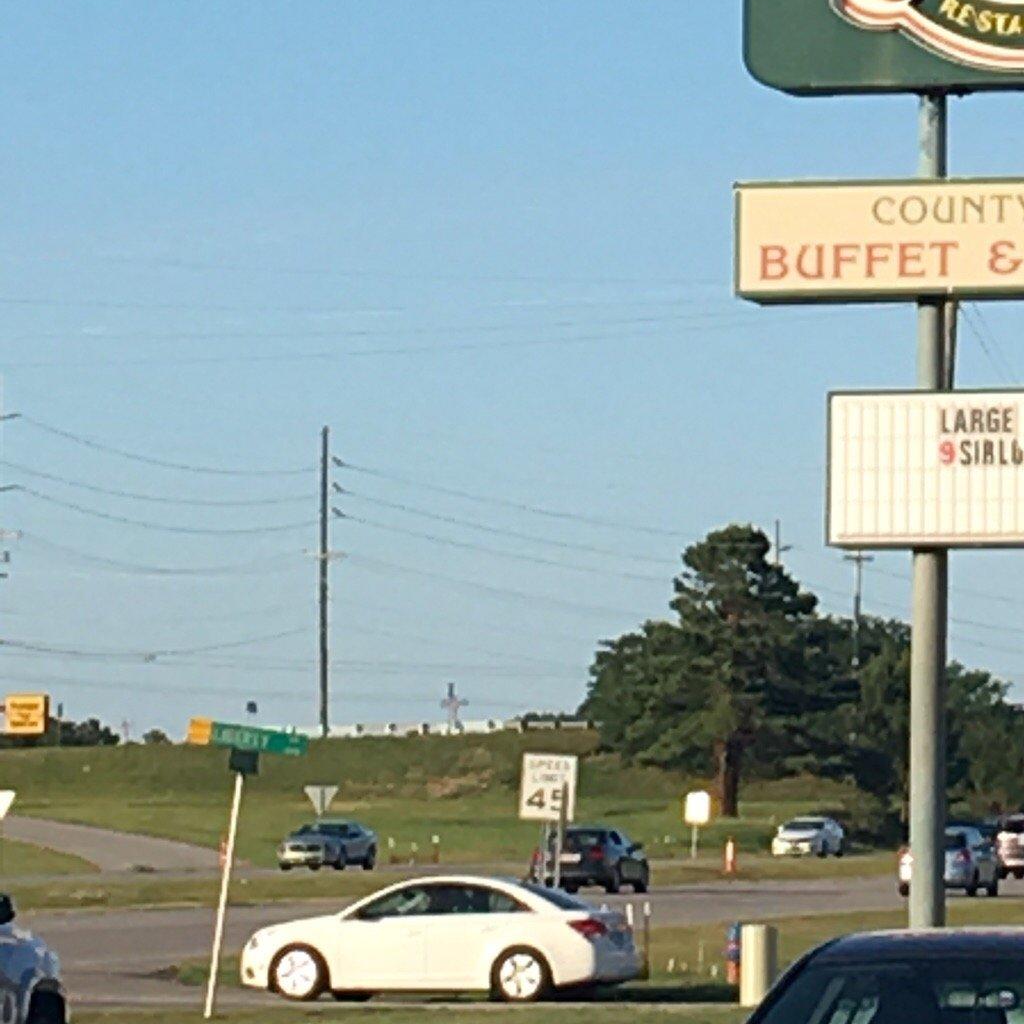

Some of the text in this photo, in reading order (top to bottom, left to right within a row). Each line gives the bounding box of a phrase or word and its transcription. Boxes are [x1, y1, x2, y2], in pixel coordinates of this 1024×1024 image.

[759, 240, 960, 281] BUFFET
[987, 240, 1023, 276] &
[940, 406, 1014, 434] LARGE
[526, 787, 566, 812] 45
